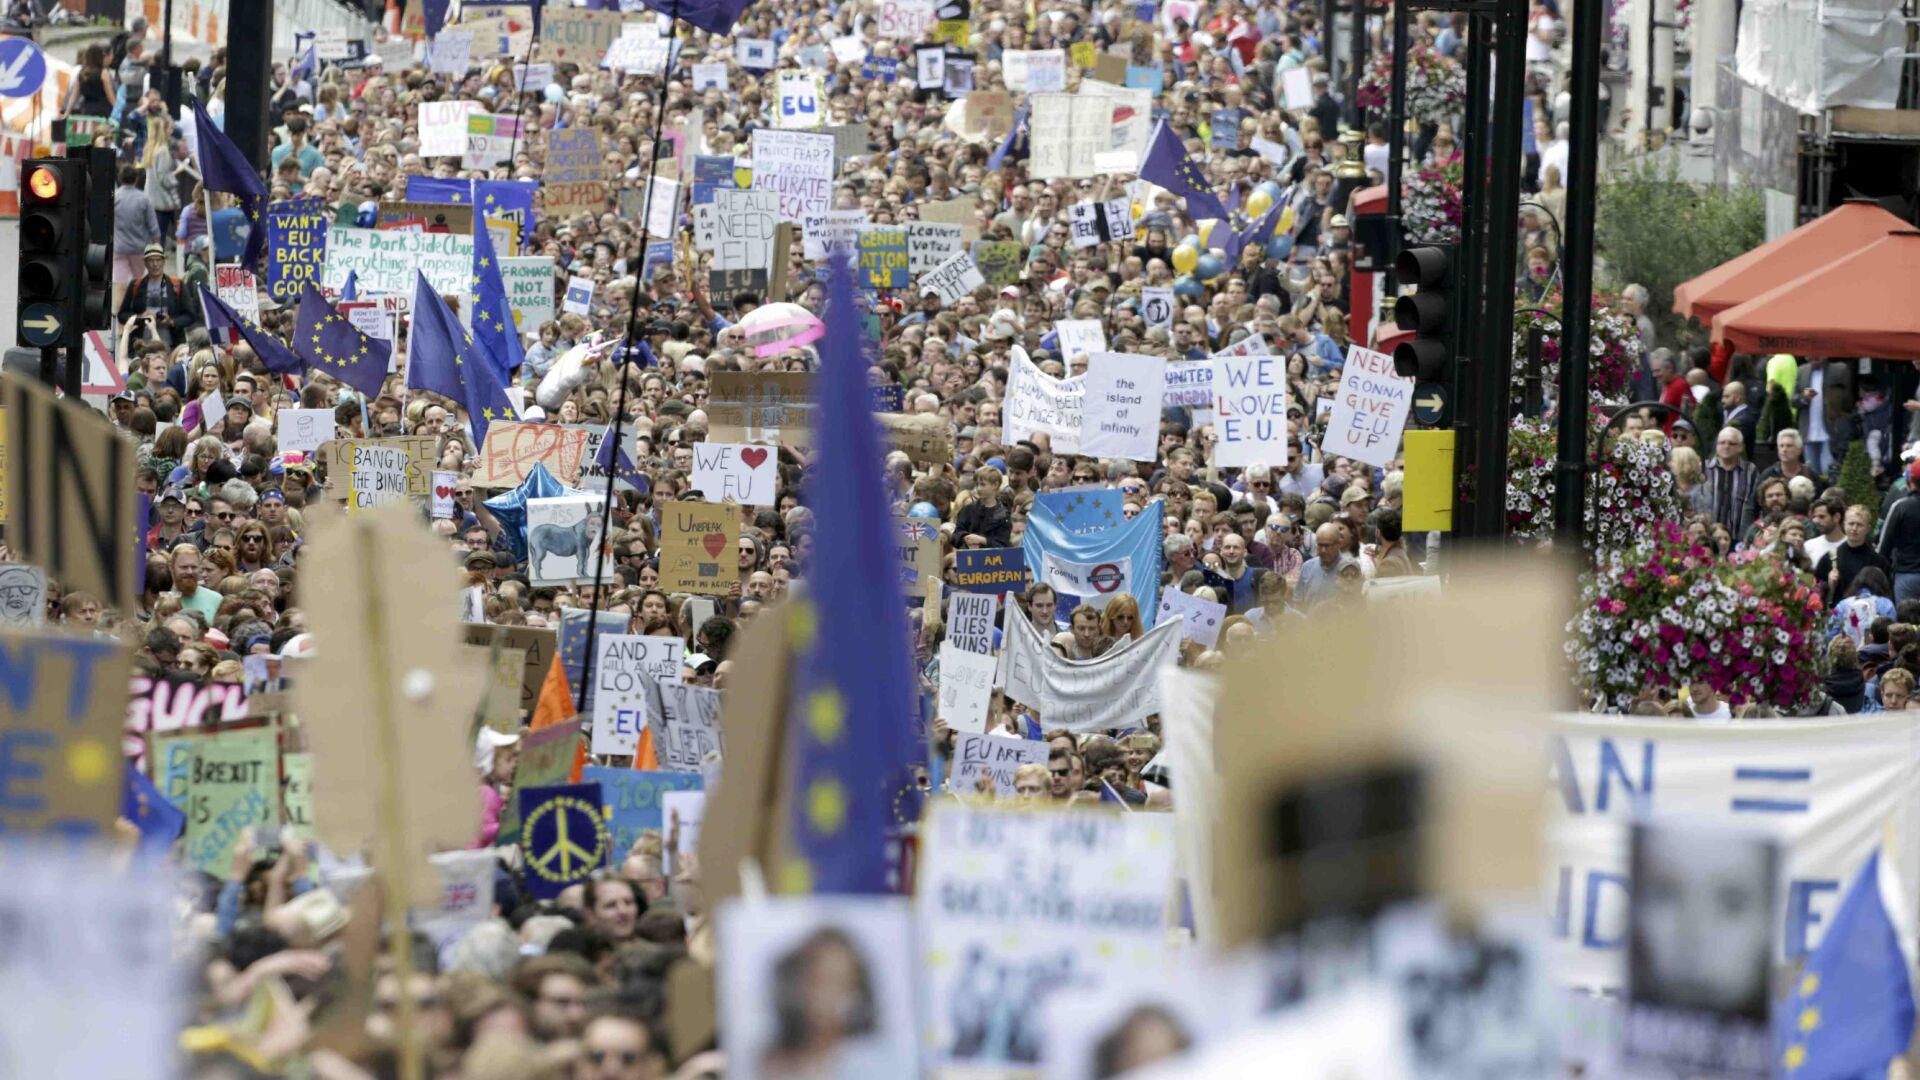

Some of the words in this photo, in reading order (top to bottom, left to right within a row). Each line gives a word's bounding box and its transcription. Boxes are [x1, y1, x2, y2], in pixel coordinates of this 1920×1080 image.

[783, 96, 815, 116] EU
[716, 190, 738, 212] WE
[743, 194, 775, 212] ALL
[276, 215, 322, 229] WANT
[718, 212, 775, 241] NEED
[288, 230, 311, 246] EU
[332, 229, 362, 248] The
[369, 232, 407, 251] Dark
[822, 239, 857, 254] VOT
[860, 231, 906, 248] GENER
[276, 247, 323, 263] BACK
[722, 240, 768, 271] EU
[861, 252, 908, 269] ATION
[217, 267, 254, 288] STOP
[282, 263, 315, 280] FOR
[501, 265, 553, 278] FROMAGE
[725, 271, 753, 288] EU
[869, 269, 892, 288] 48
[407, 270, 458, 294] Fture
[513, 281, 544, 295] NOT
[1164, 367, 1213, 385] UNITED
[1225, 360, 1274, 388] WE
[1116, 378, 1135, 390] the
[1347, 375, 1404, 400] GONNA
[1106, 391, 1142, 405] island
[1346, 393, 1395, 418] GIVE
[1116, 408, 1128, 419] of
[1100, 421, 1140, 437] infinity
[1225, 418, 1278, 442] E.U.
[1346, 430, 1380, 448] UP
[353, 447, 392, 470] BANG
[397, 453, 409, 472] UP
[695, 447, 732, 471] WE
[352, 470, 369, 489] THE
[375, 471, 408, 497] BINGO
[723, 474, 752, 500] EU
[687, 538, 699, 546] MY
[967, 555, 973, 567] I
[984, 555, 1003, 566] AM
[958, 570, 1022, 586] EUROPEAN
[955, 596, 991, 617] WHO
[953, 616, 988, 636] LIES
[604, 641, 648, 661] AND
[661, 642, 678, 662] I
[603, 660, 625, 673] WILL
[634, 661, 677, 675] AWAYS
[964, 737, 993, 760] EU
[996, 746, 1027, 763] ARE
[193, 756, 262, 785] BREXIT
[961, 764, 977, 778] MY
[191, 795, 209, 825] IS
